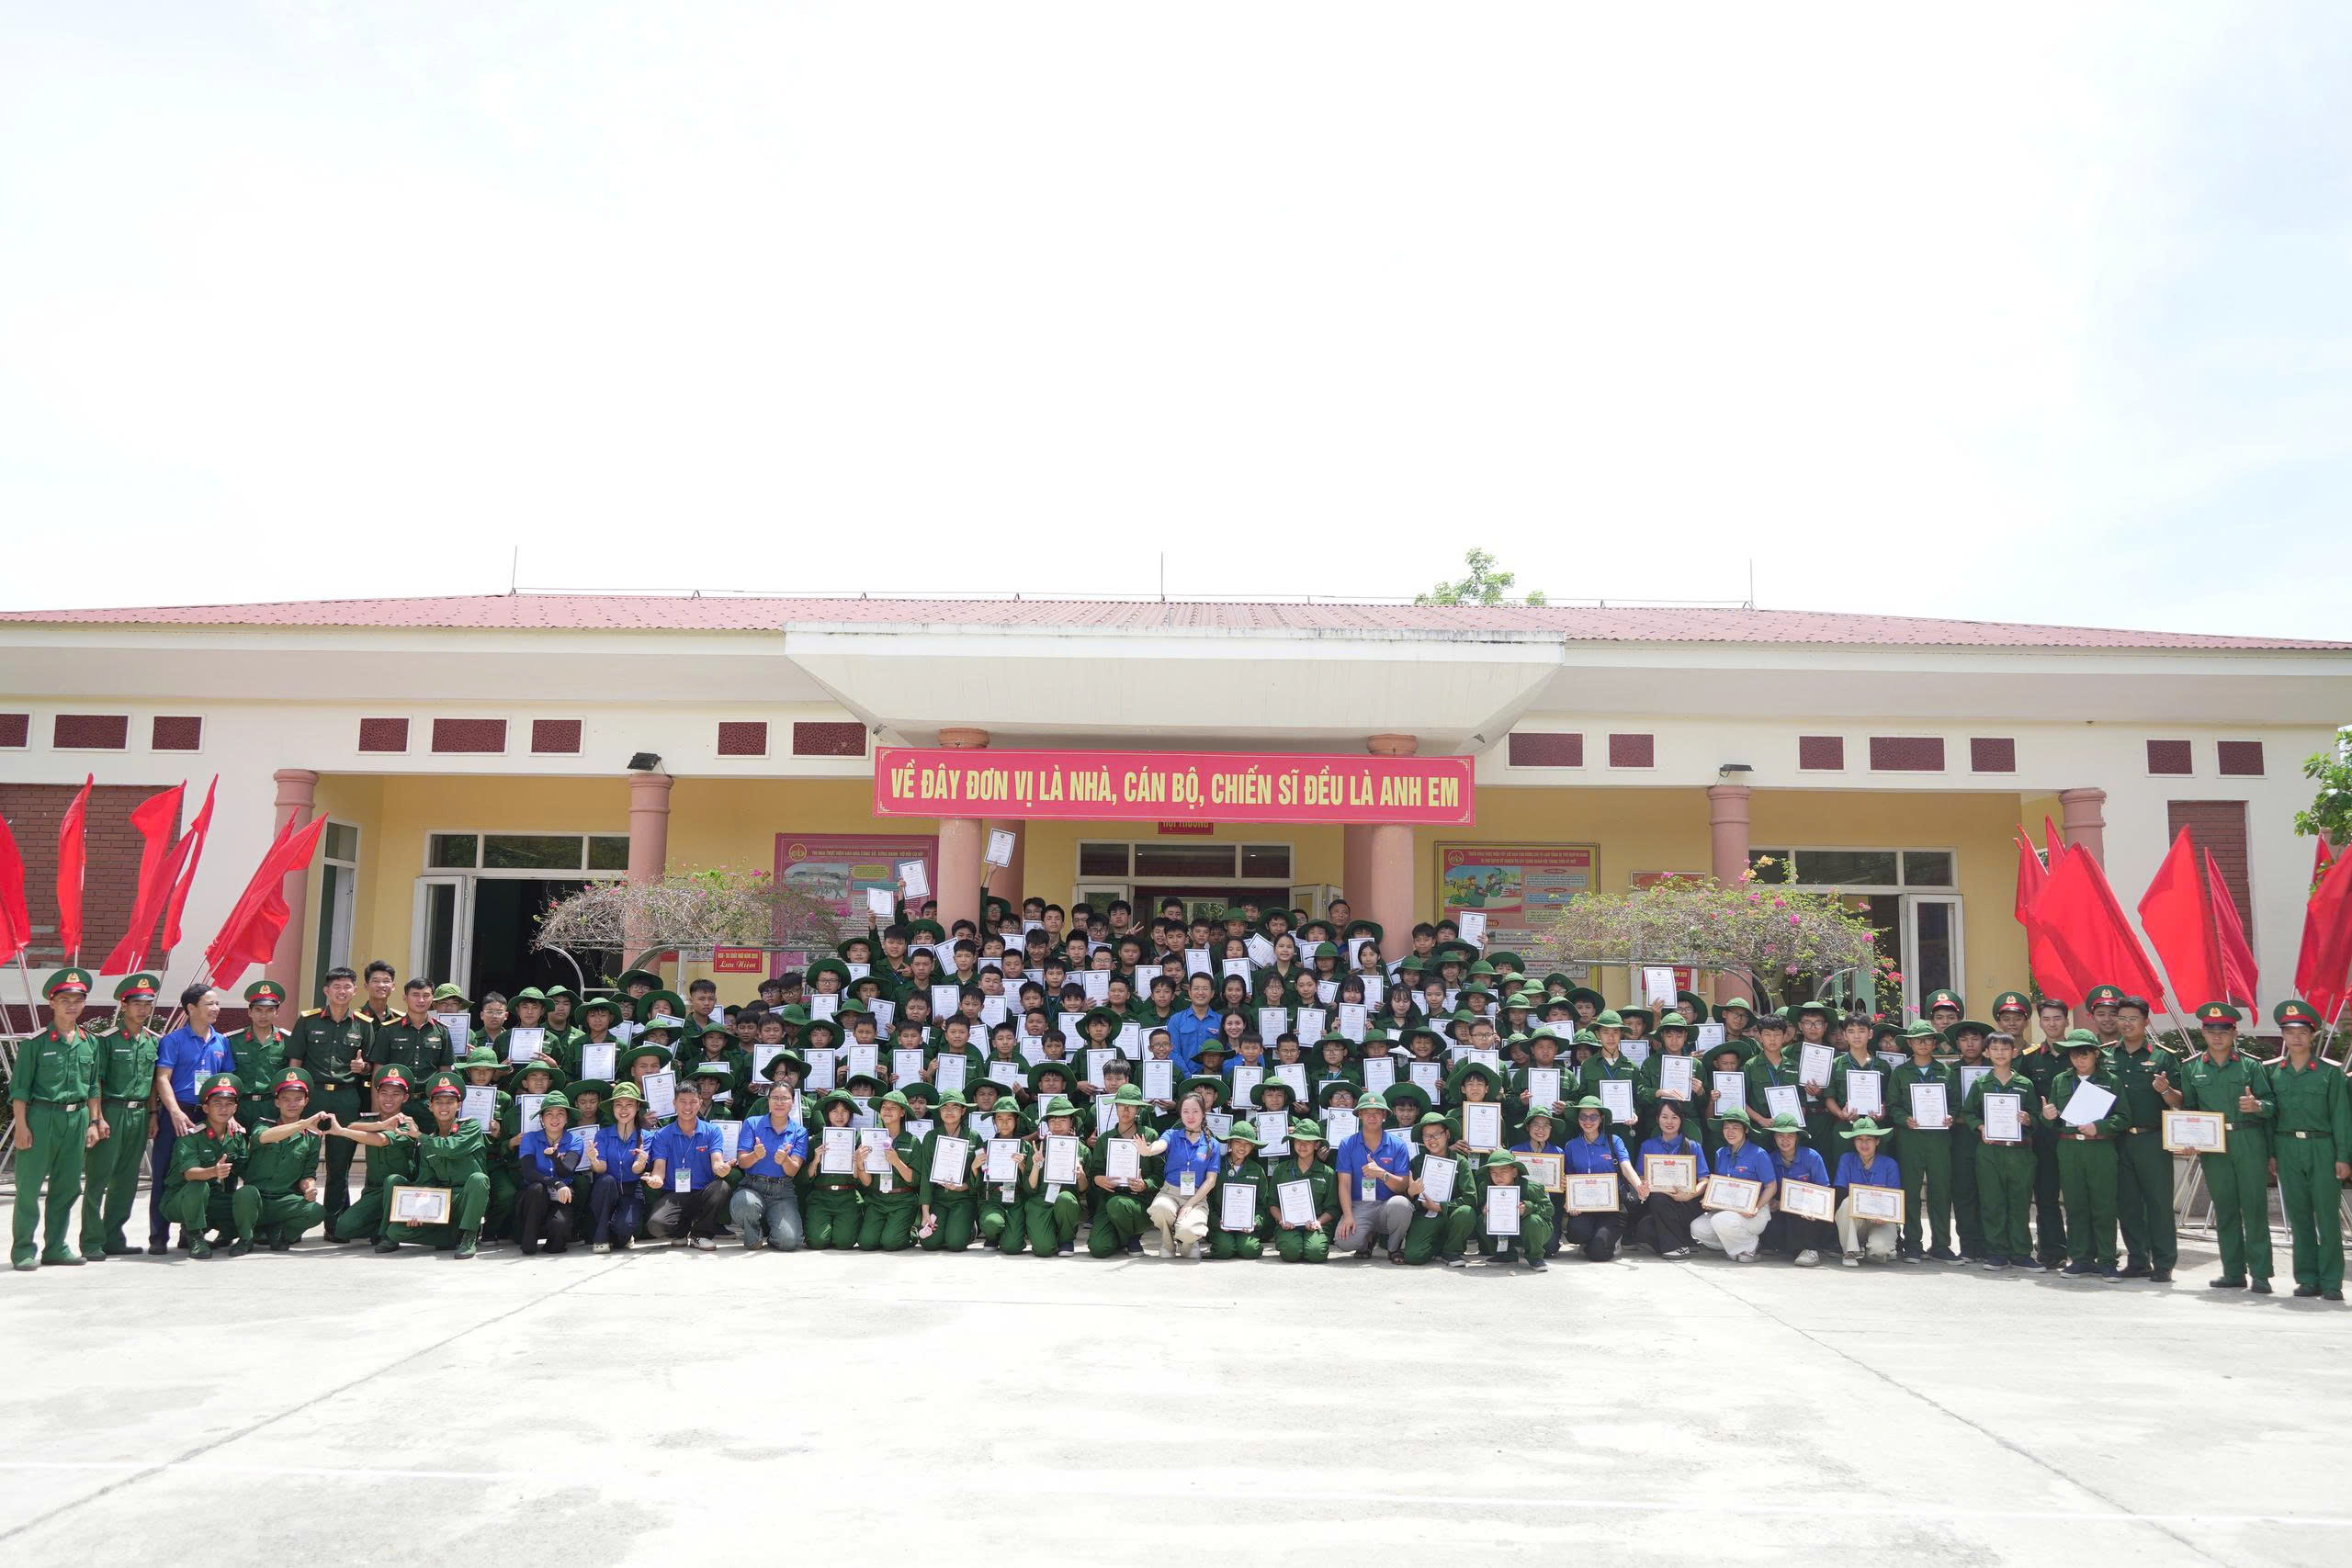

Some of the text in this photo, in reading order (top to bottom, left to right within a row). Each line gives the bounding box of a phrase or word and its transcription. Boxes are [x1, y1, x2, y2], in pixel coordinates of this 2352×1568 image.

[890, 760, 1459, 809] VỀ ĐÂY ĐƠN VỊ LÀ NHÀ, CÁN BỘ, CHIẾN SĨ ĐỀU LÀ ANH EM
